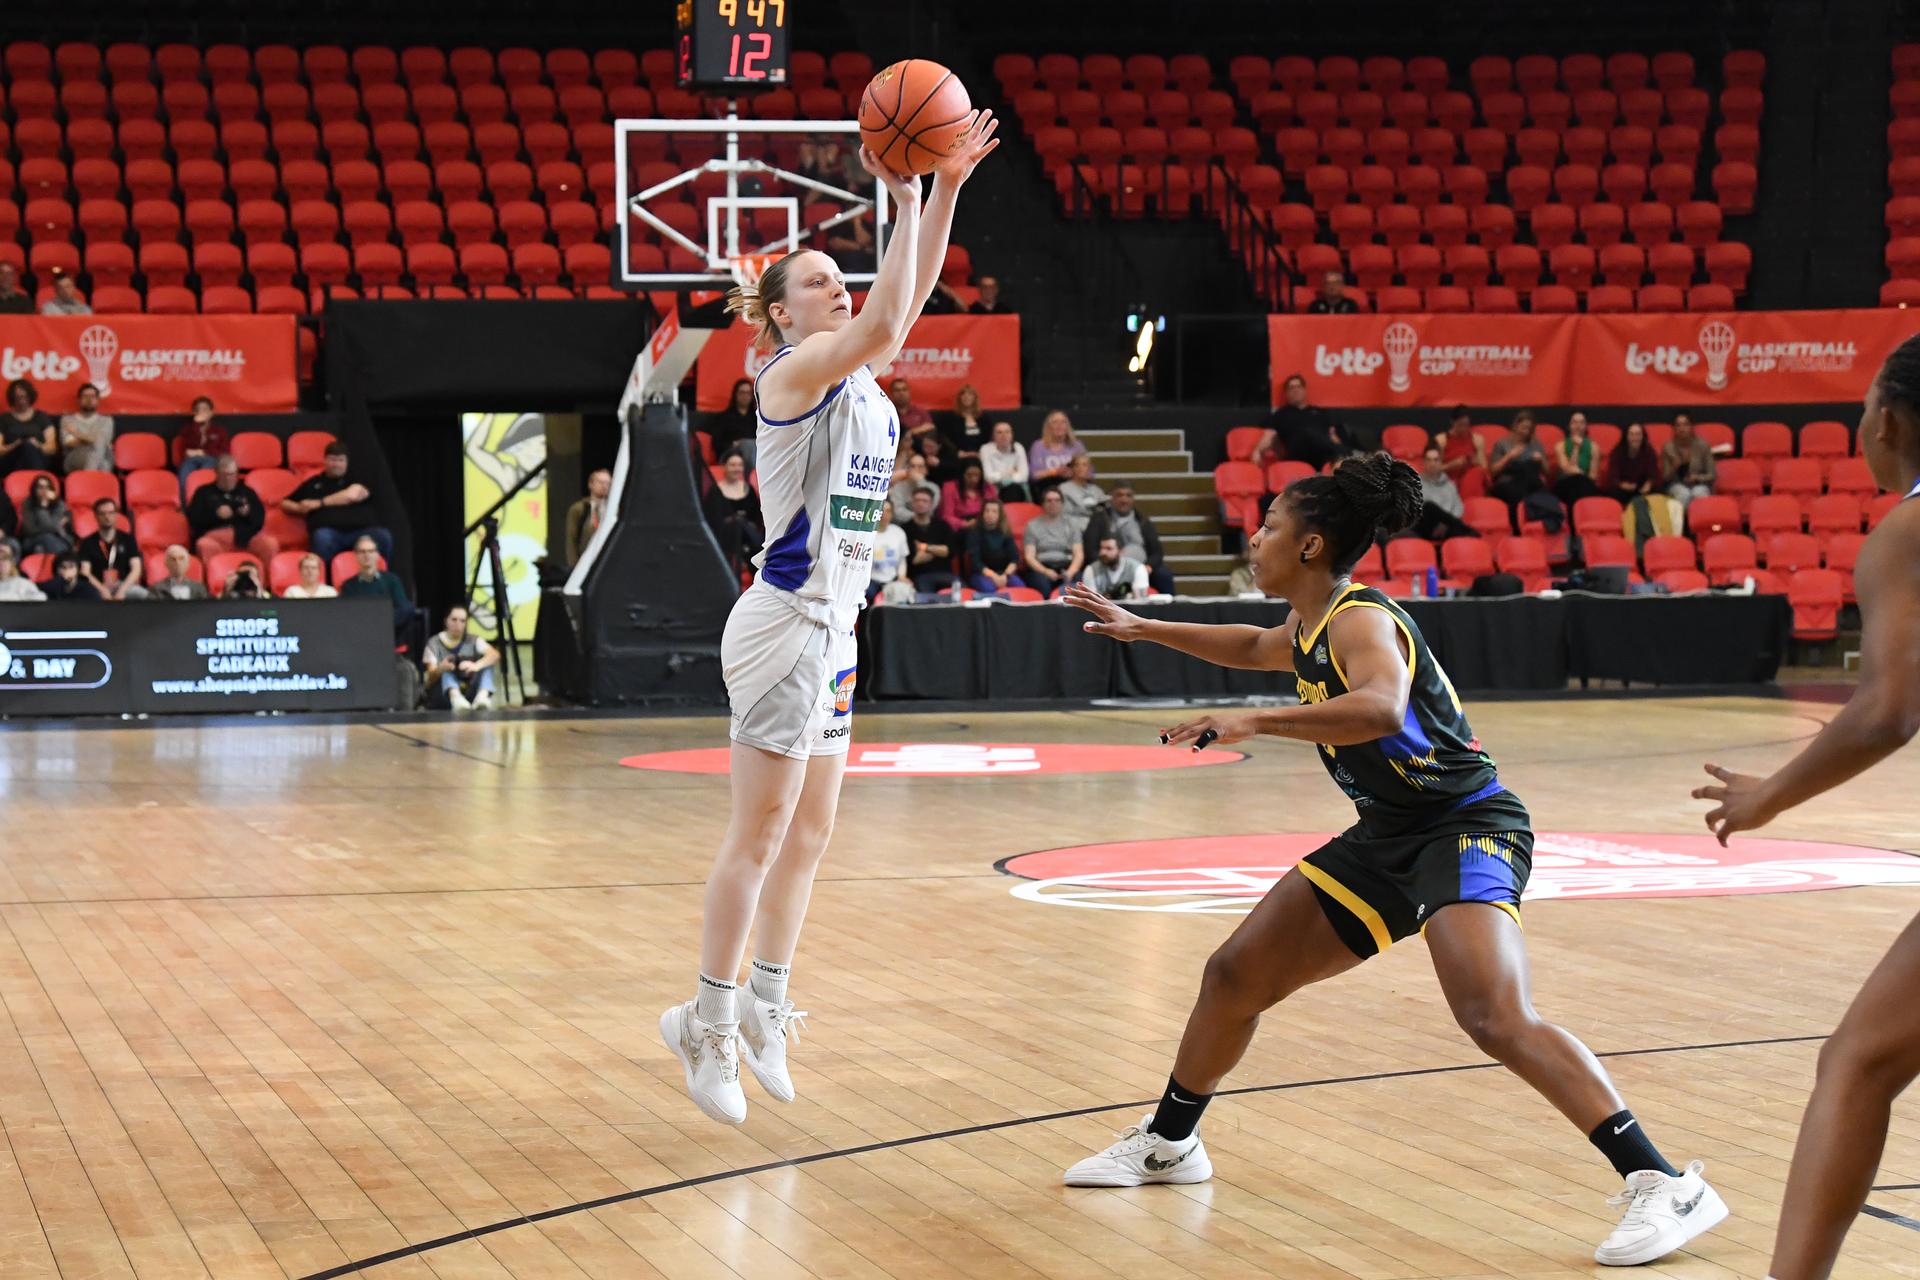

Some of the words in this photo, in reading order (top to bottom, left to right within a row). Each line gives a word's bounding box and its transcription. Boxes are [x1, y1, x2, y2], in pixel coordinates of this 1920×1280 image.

[729, 33, 771, 78] 12
[120, 350, 246, 365] BASKETBALL
[1420, 346, 1533, 360] BASKETBALL
[1737, 342, 1858, 357] BASKETBALL
[121, 365, 162, 381] CUP
[1420, 360, 1456, 375] CUP
[1737, 358, 1777, 373] CUP
[215, 618, 279, 637] SIROPS
[196, 636, 300, 655] SPIRITUEUX
[10, 658, 27, 679] &
[33, 658, 77, 679] DAY
[207, 655, 290, 673] CADEAUX
